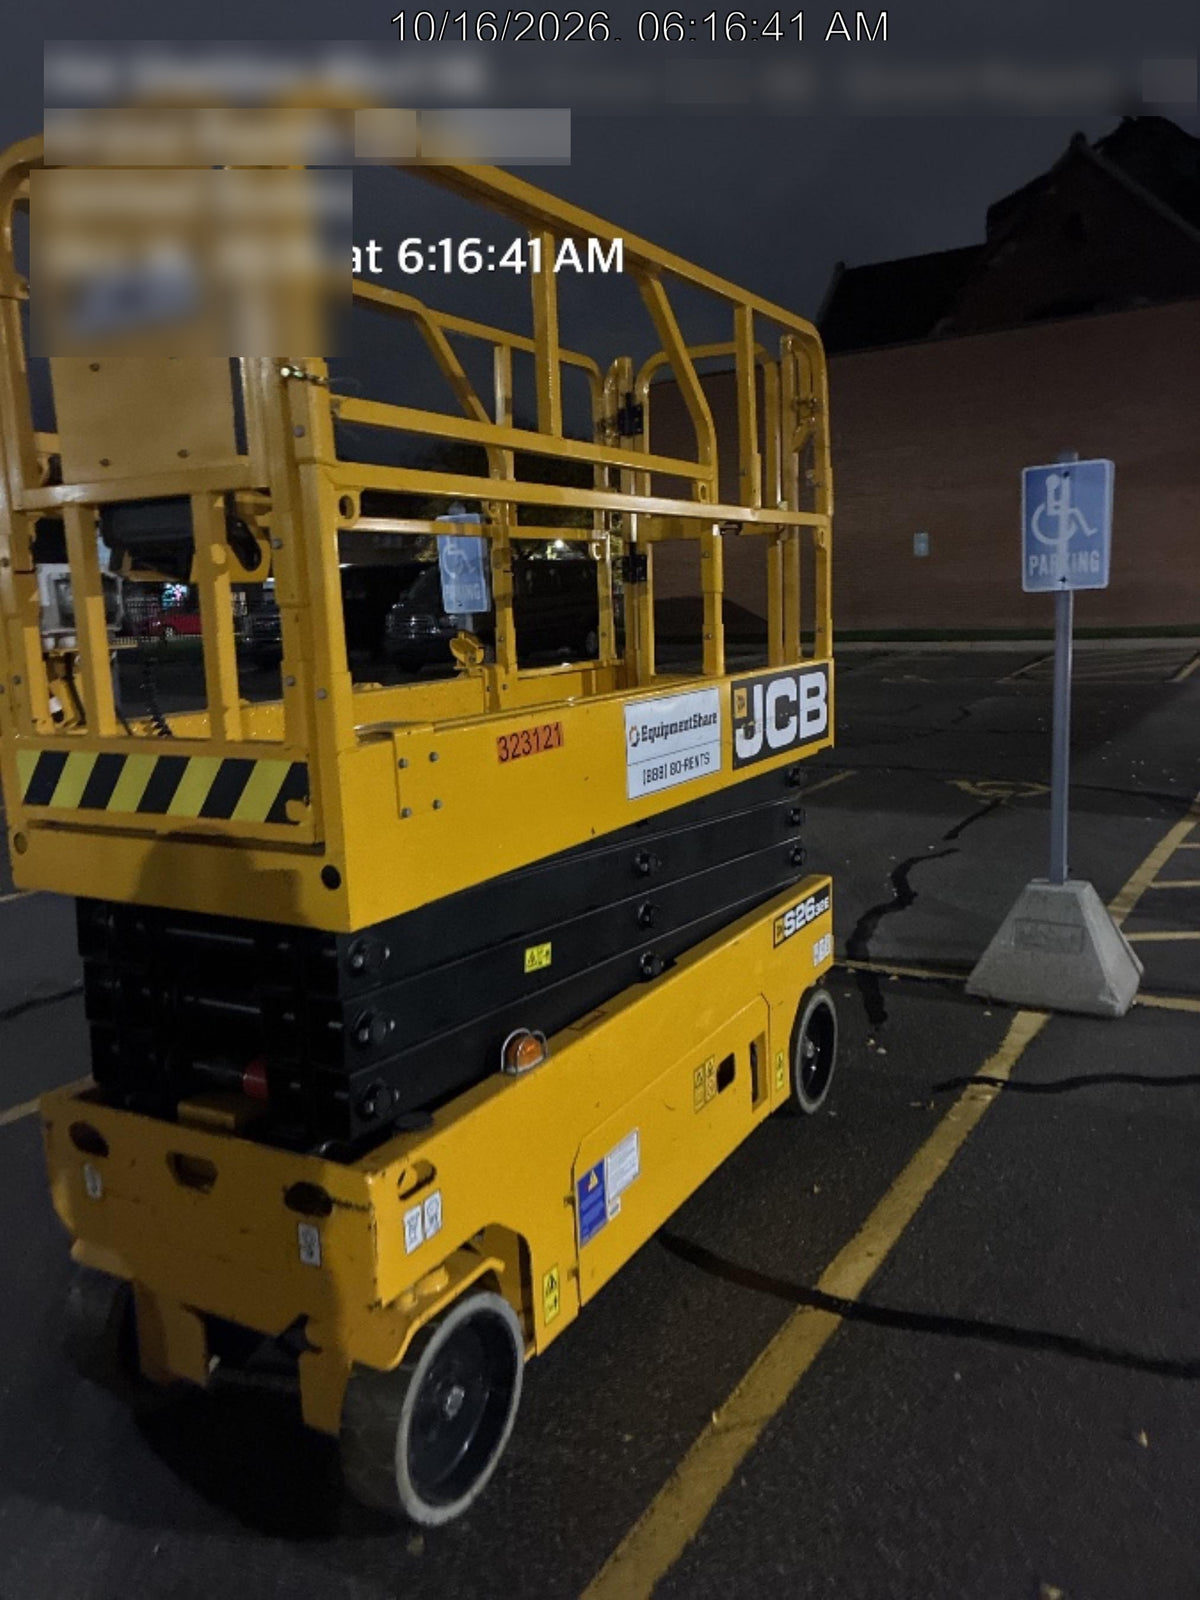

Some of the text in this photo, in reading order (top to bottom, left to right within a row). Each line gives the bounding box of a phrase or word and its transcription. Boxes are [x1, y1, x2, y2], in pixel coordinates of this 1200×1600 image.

[640, 711, 718, 744] EquipmentShare
[735, 671, 828, 758] JCB
[497, 722, 563, 762] 323121
